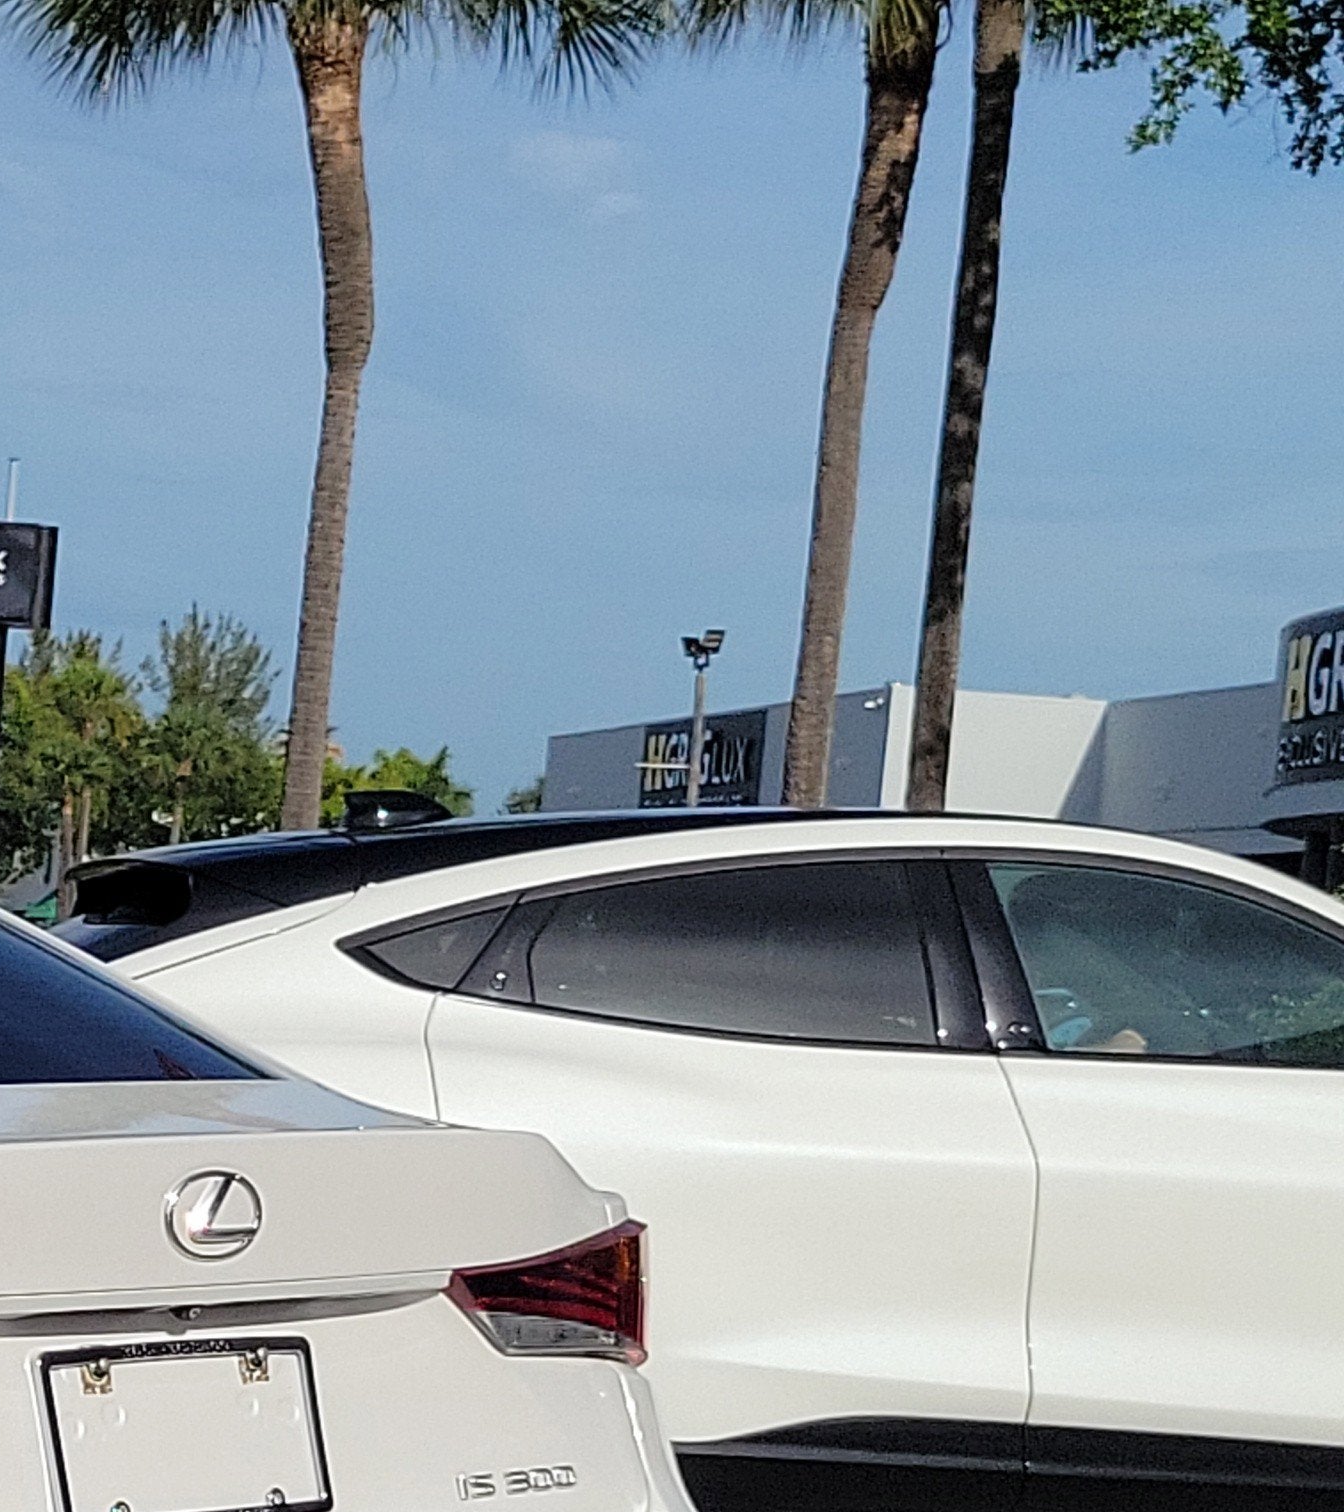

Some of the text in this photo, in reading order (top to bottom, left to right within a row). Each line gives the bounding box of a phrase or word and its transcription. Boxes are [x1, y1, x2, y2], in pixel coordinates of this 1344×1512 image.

[712, 736, 748, 785] LUX
[454, 1464, 579, 1501] IS 300
